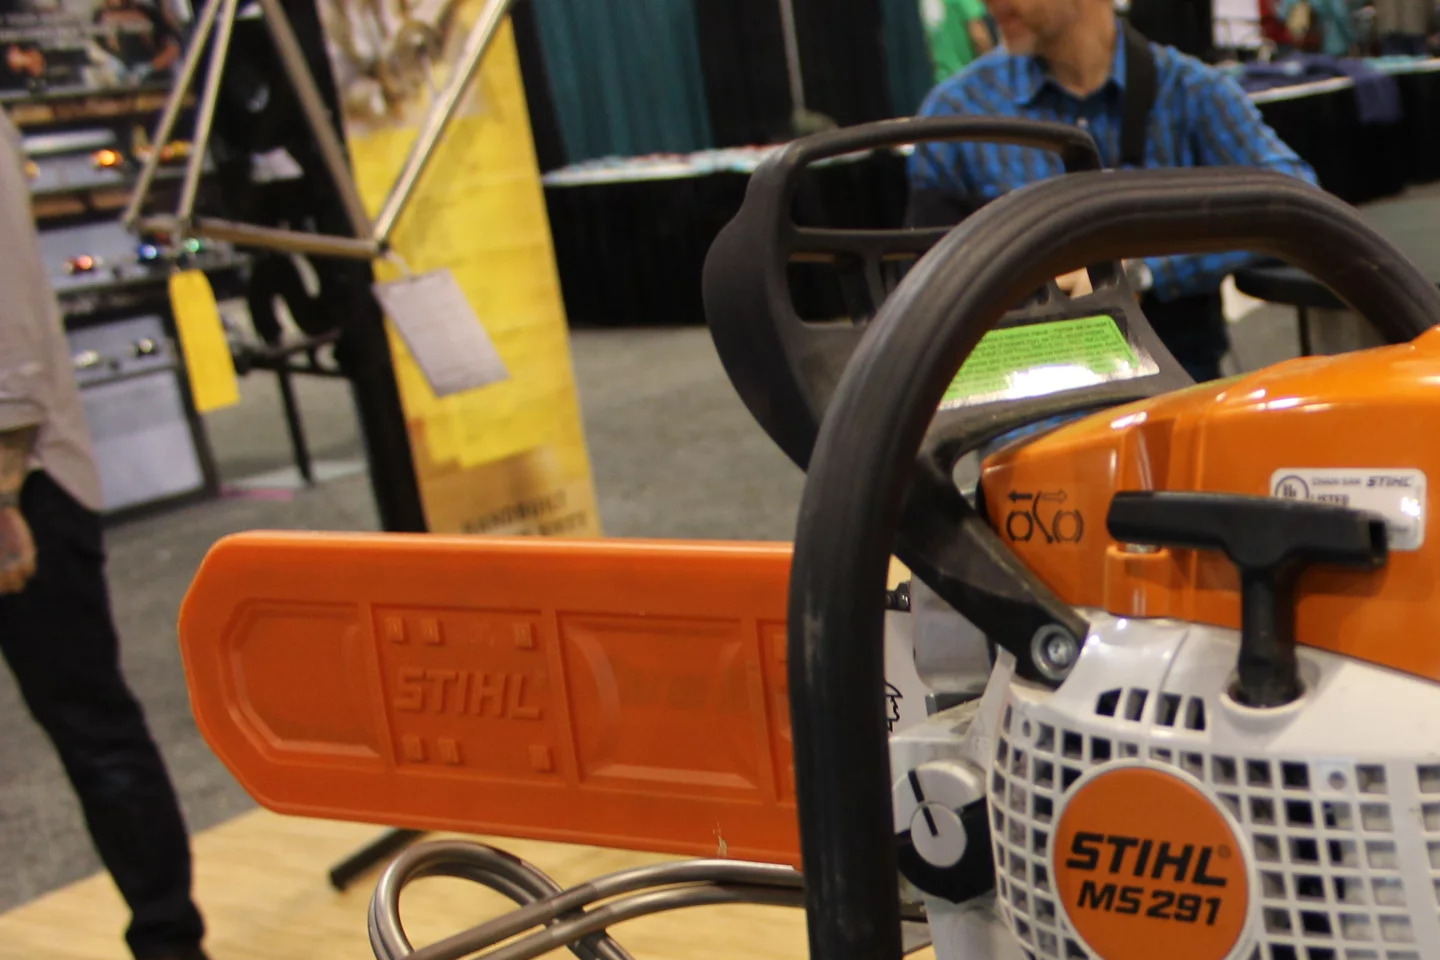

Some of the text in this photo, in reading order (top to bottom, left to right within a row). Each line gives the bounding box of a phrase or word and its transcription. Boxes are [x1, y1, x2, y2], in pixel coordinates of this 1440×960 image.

[393, 668, 542, 721] STIHL
[1077, 880, 1222, 927] MS 291
